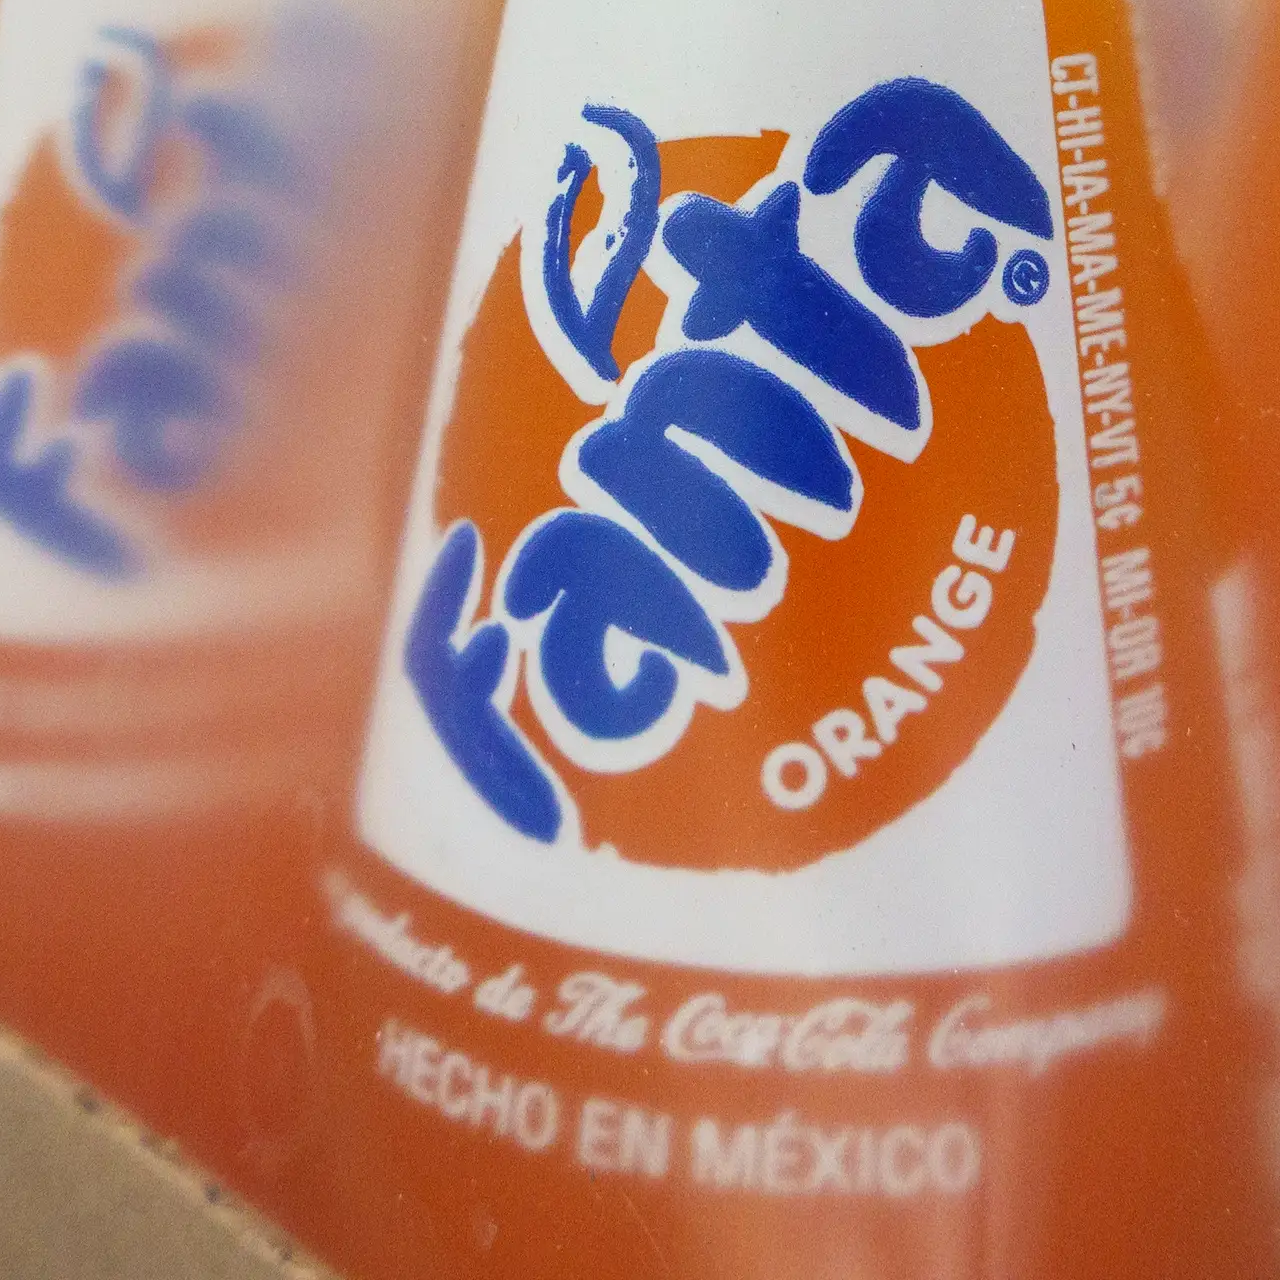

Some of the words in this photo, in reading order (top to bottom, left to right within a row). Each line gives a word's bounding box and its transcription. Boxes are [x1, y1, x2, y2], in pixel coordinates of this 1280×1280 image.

[403, 75, 1054, 846] Fanta
[1051, 51, 1141, 472] CT-HI-IA-MA-ME-NY-VT
[1100, 546, 1162, 687] MI-OR
[761, 513, 1015, 811] ORANGE
[377, 1020, 560, 1153] HECHO
[575, 1094, 673, 1180] EN
[687, 1107, 985, 1199] MÉXICO
[474, 963, 538, 1022] de
[542, 970, 650, 1053] The
